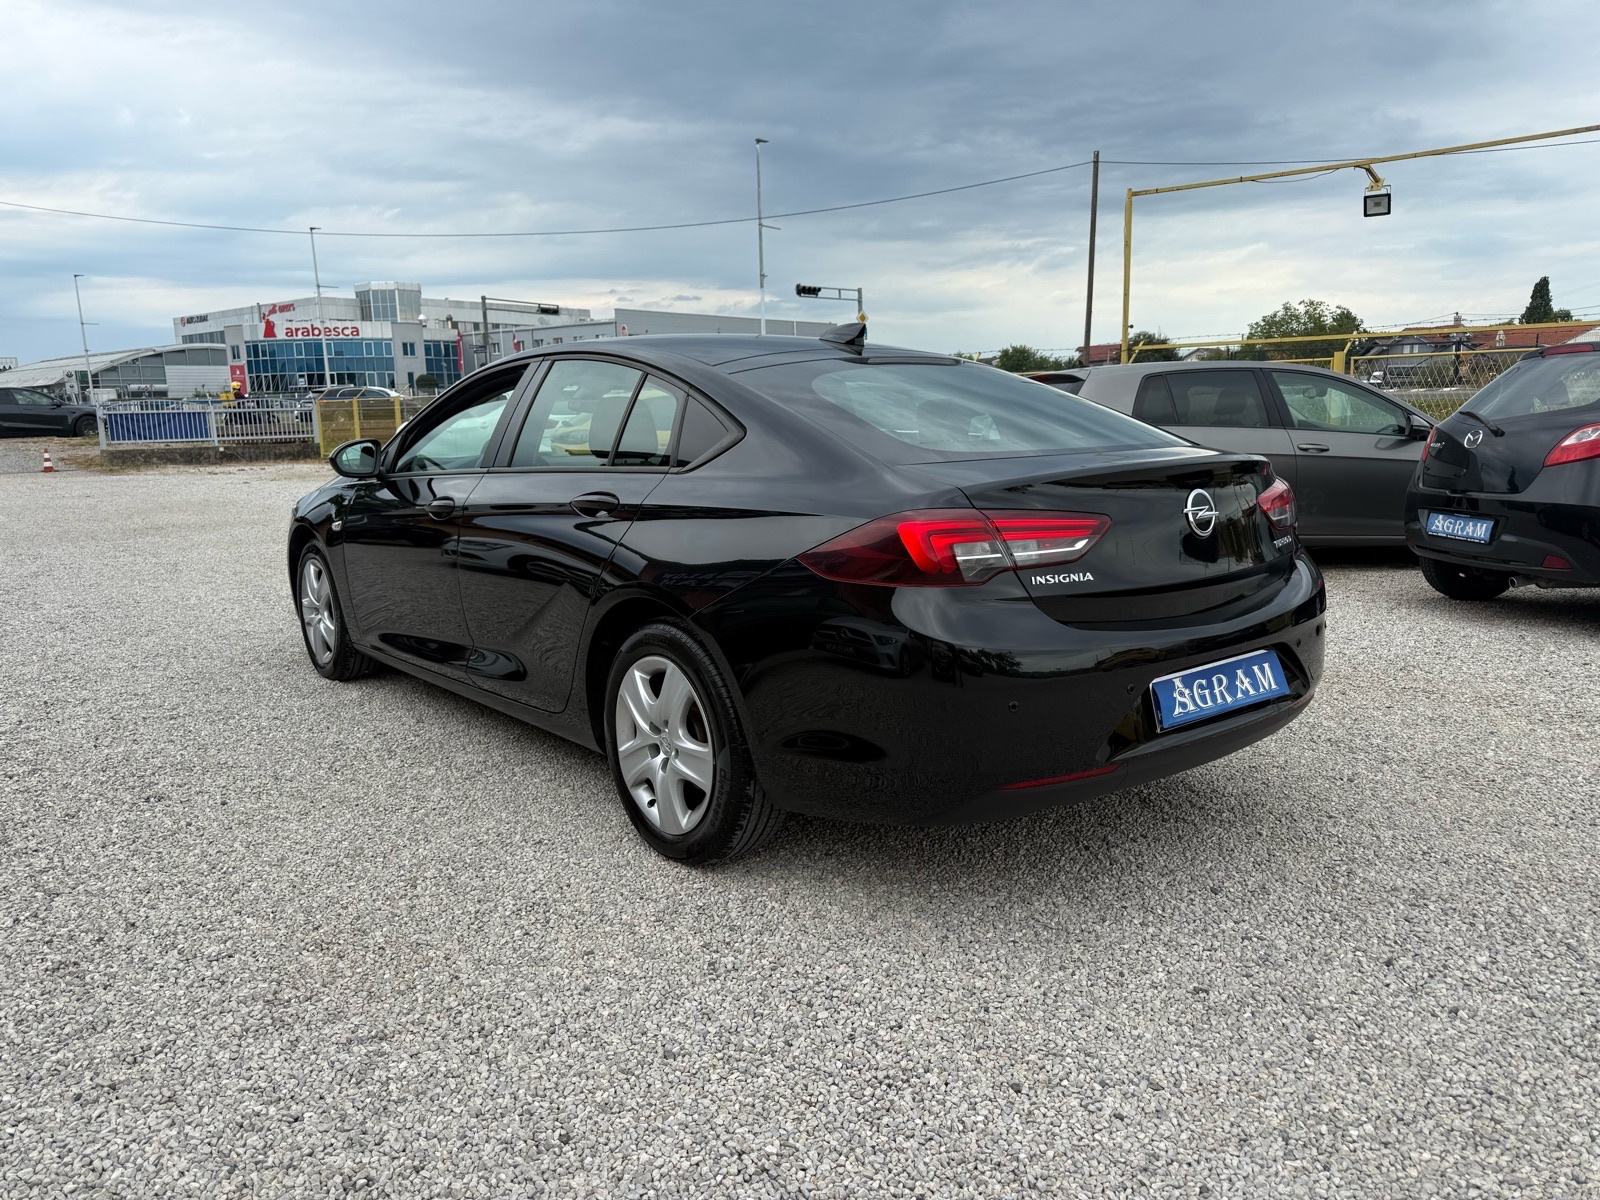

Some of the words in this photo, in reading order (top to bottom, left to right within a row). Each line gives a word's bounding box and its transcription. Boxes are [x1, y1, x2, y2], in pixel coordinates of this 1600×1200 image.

[285, 324, 360, 337] arabesca
[1031, 572, 1094, 585] INSIGNIA
[1173, 663, 1280, 717] AGRAM
